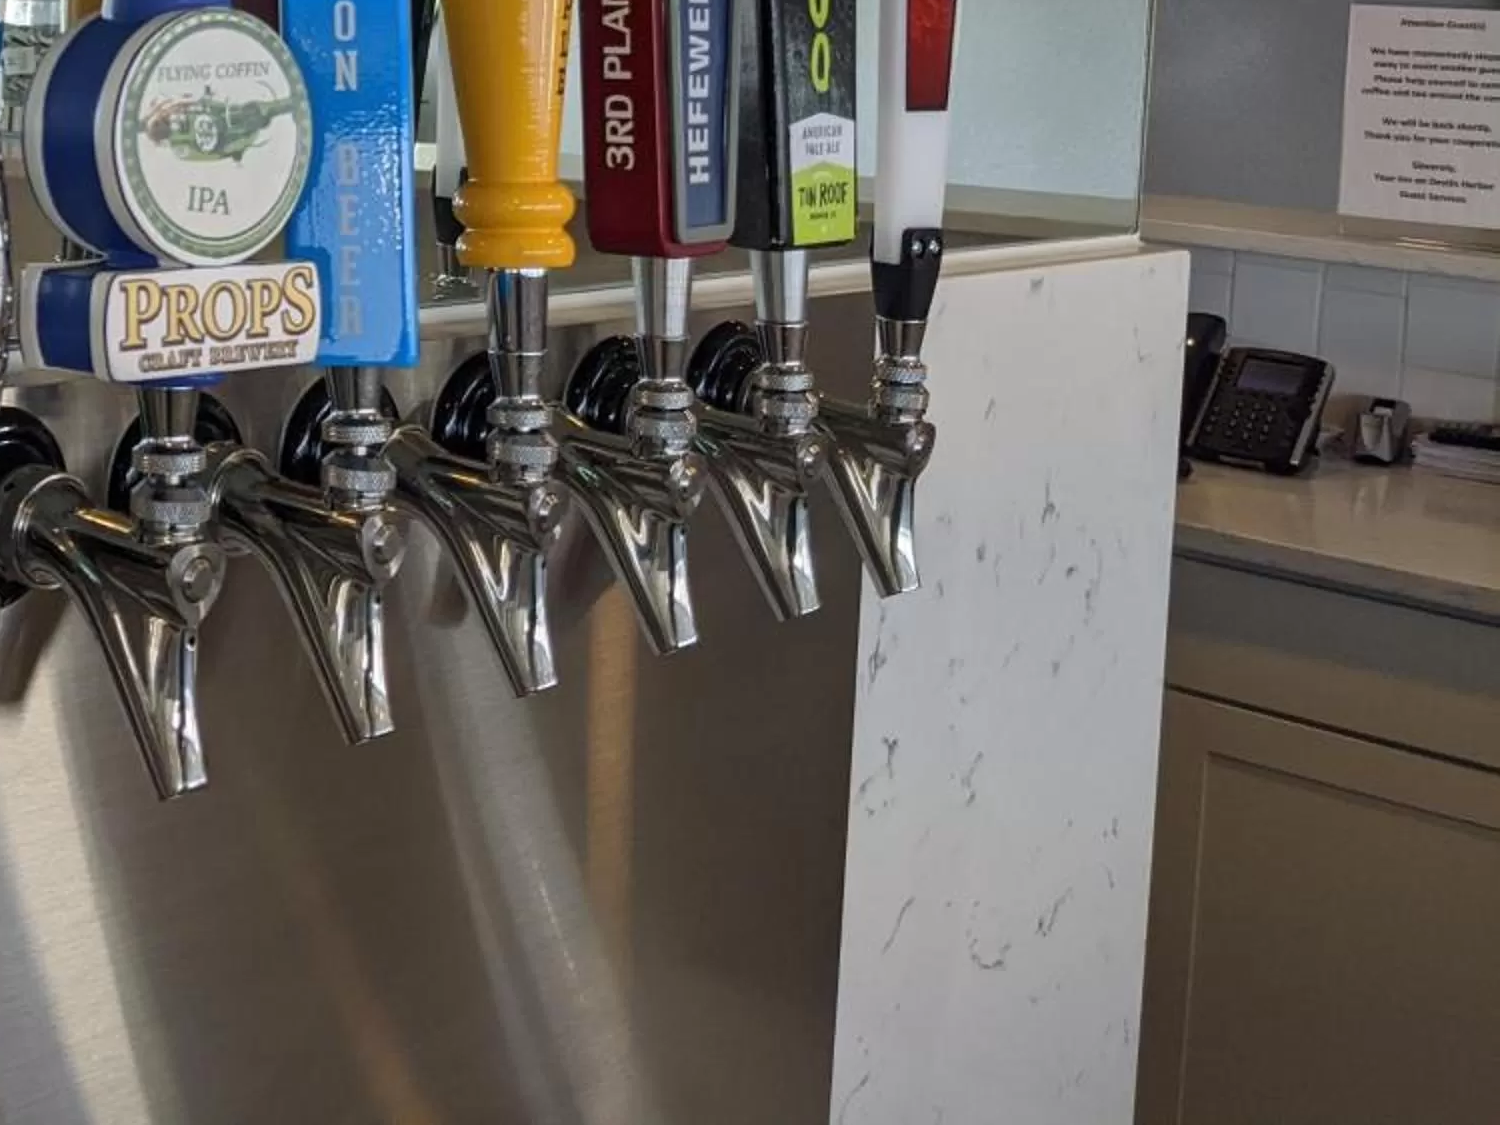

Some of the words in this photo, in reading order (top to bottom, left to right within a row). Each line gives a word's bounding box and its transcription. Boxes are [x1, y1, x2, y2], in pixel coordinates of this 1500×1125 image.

[157, 63, 212, 83] FLYING
[214, 60, 272, 80] COFFIN
[604, 93, 636, 172] 3RD
[186, 185, 232, 216] IPA
[797, 185, 817, 208] TIN
[818, 180, 849, 208] ROOF
[332, 141, 364, 338] BEER
[119, 265, 316, 352] PROPS
[138, 348, 203, 373] CRAFT
[208, 339, 299, 366] BREWERY
